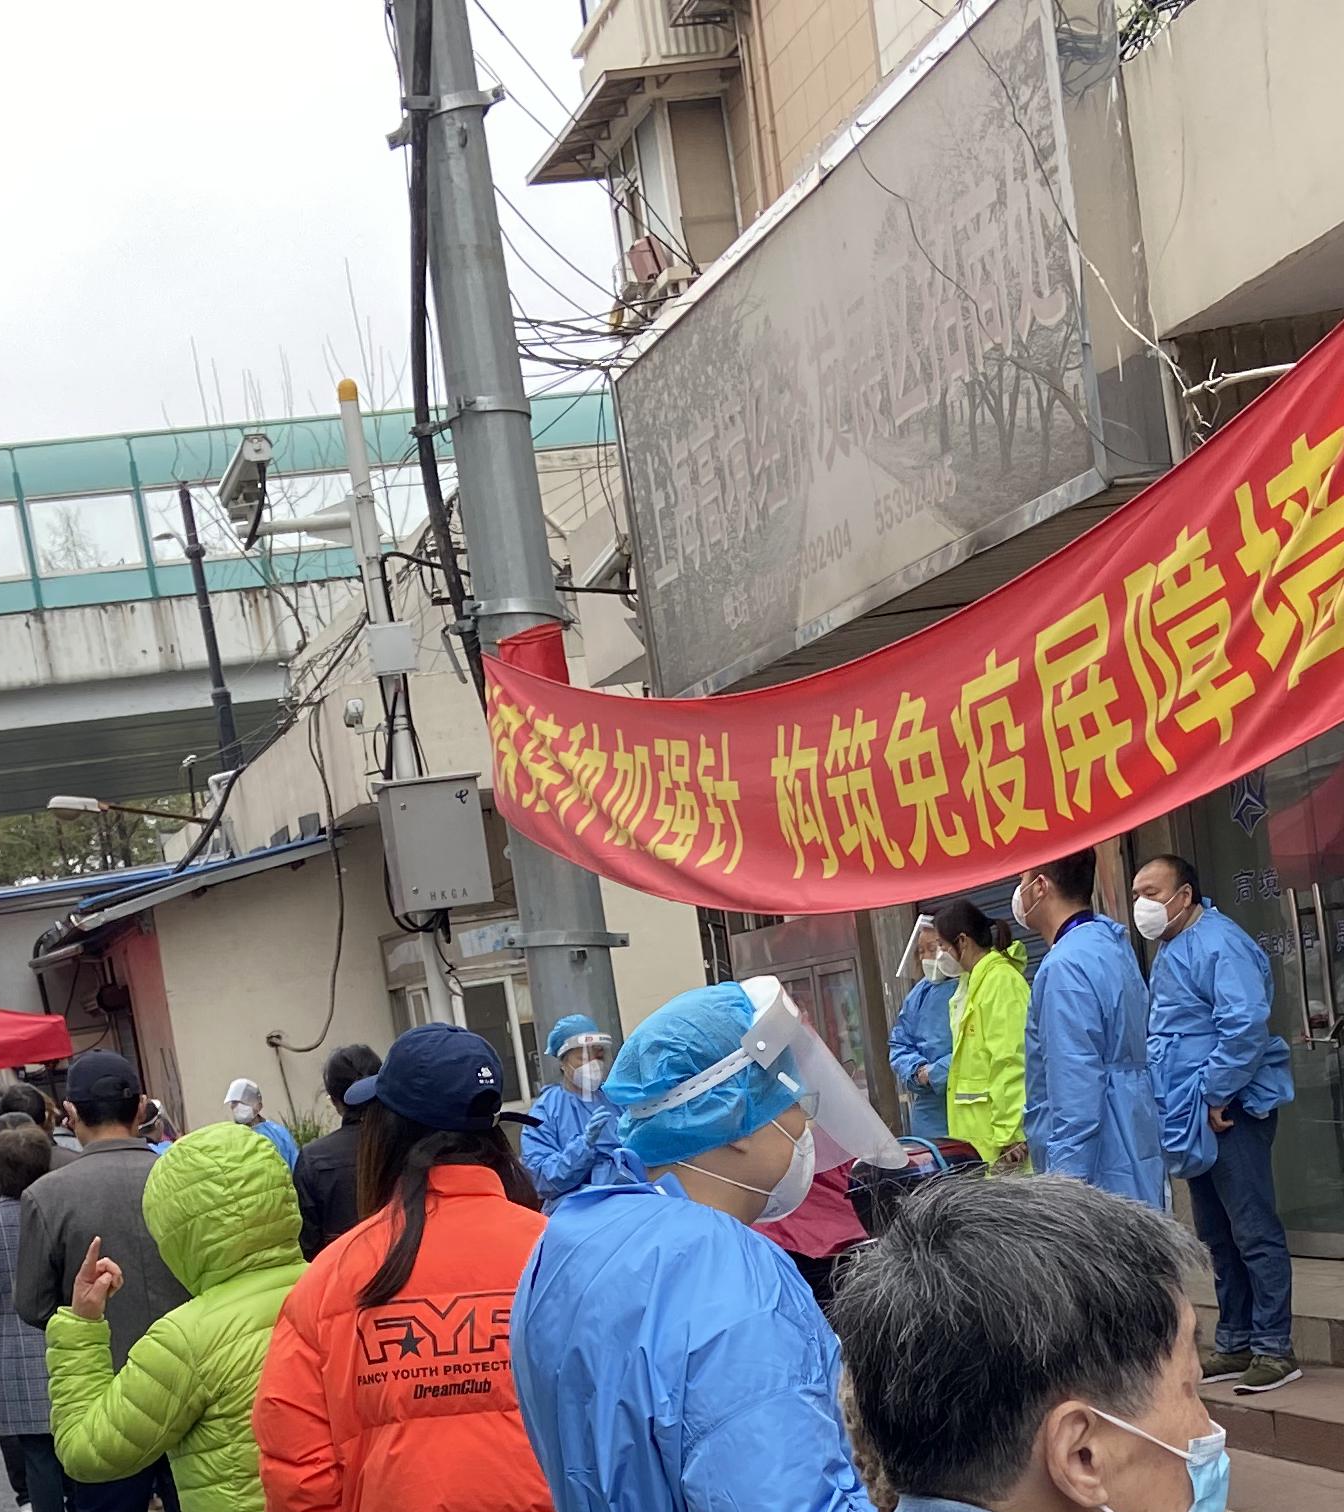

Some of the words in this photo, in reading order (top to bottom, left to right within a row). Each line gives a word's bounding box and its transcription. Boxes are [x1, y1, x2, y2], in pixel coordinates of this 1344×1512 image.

[1232, 867, 1282, 904] 高境
[357, 1371, 388, 1387] FANCY
[392, 1366, 439, 1380] YOUTH
